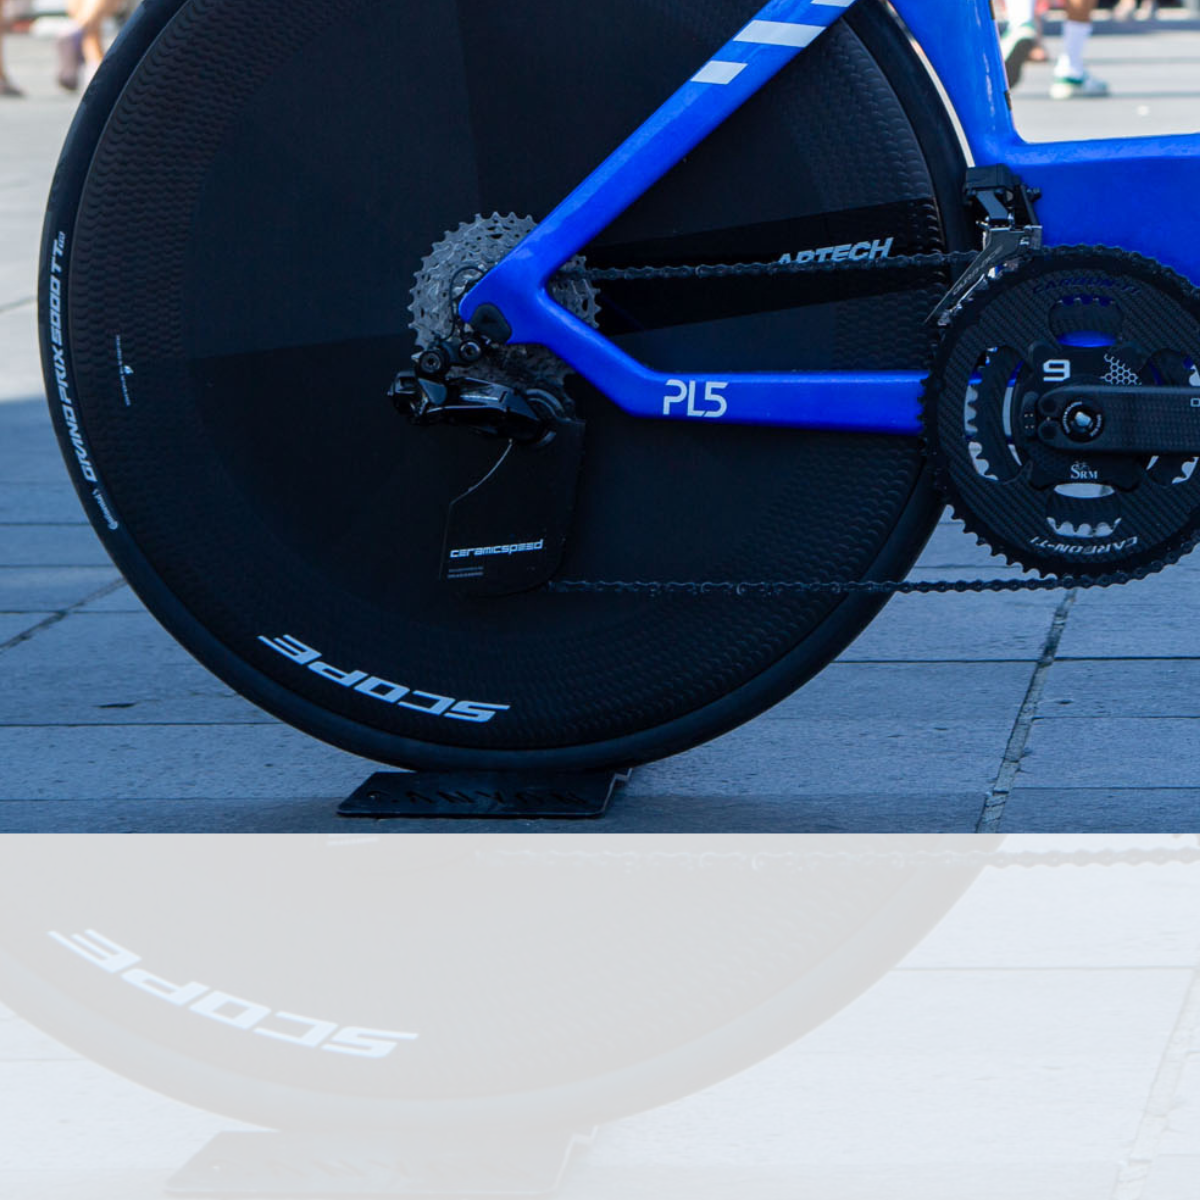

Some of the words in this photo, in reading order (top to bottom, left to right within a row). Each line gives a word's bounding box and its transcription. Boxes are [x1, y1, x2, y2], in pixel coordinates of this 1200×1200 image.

[50, 274, 63, 346] 5000
[52, 345, 72, 404] PRIX
[662, 379, 728, 417] PL5
[1043, 359, 1070, 382] 9
[62, 404, 98, 482] GRAND
[258, 634, 510, 723] SCOPE
[47, 929, 419, 1059] SCOPE
